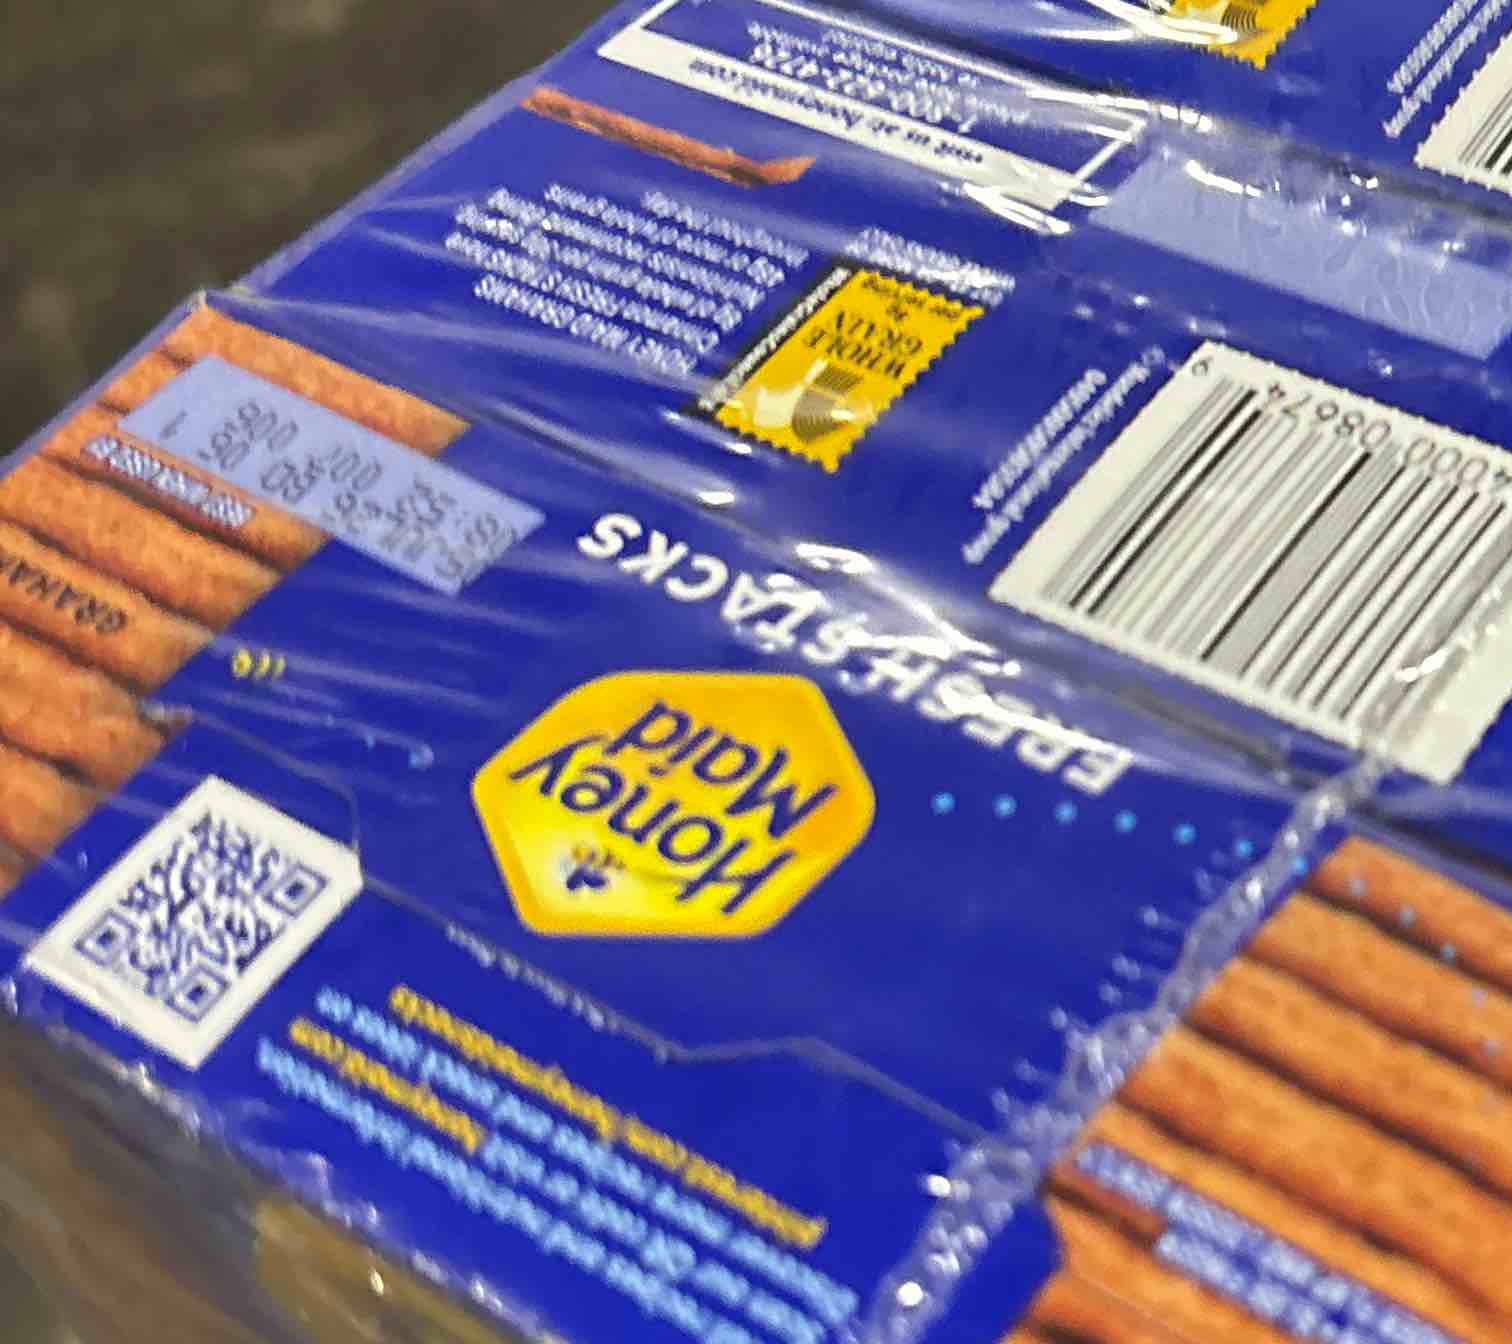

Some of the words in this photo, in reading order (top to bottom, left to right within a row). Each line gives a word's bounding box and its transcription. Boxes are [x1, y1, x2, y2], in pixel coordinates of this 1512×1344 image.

[796, 324, 912, 381] WHOLE
[823, 306, 929, 361] GRAIN
[1255, 375, 1393, 455] 08674
[573, 507, 869, 669] STACKS
[632, 702, 844, 842] Maid
[519, 741, 768, 918] Honey
